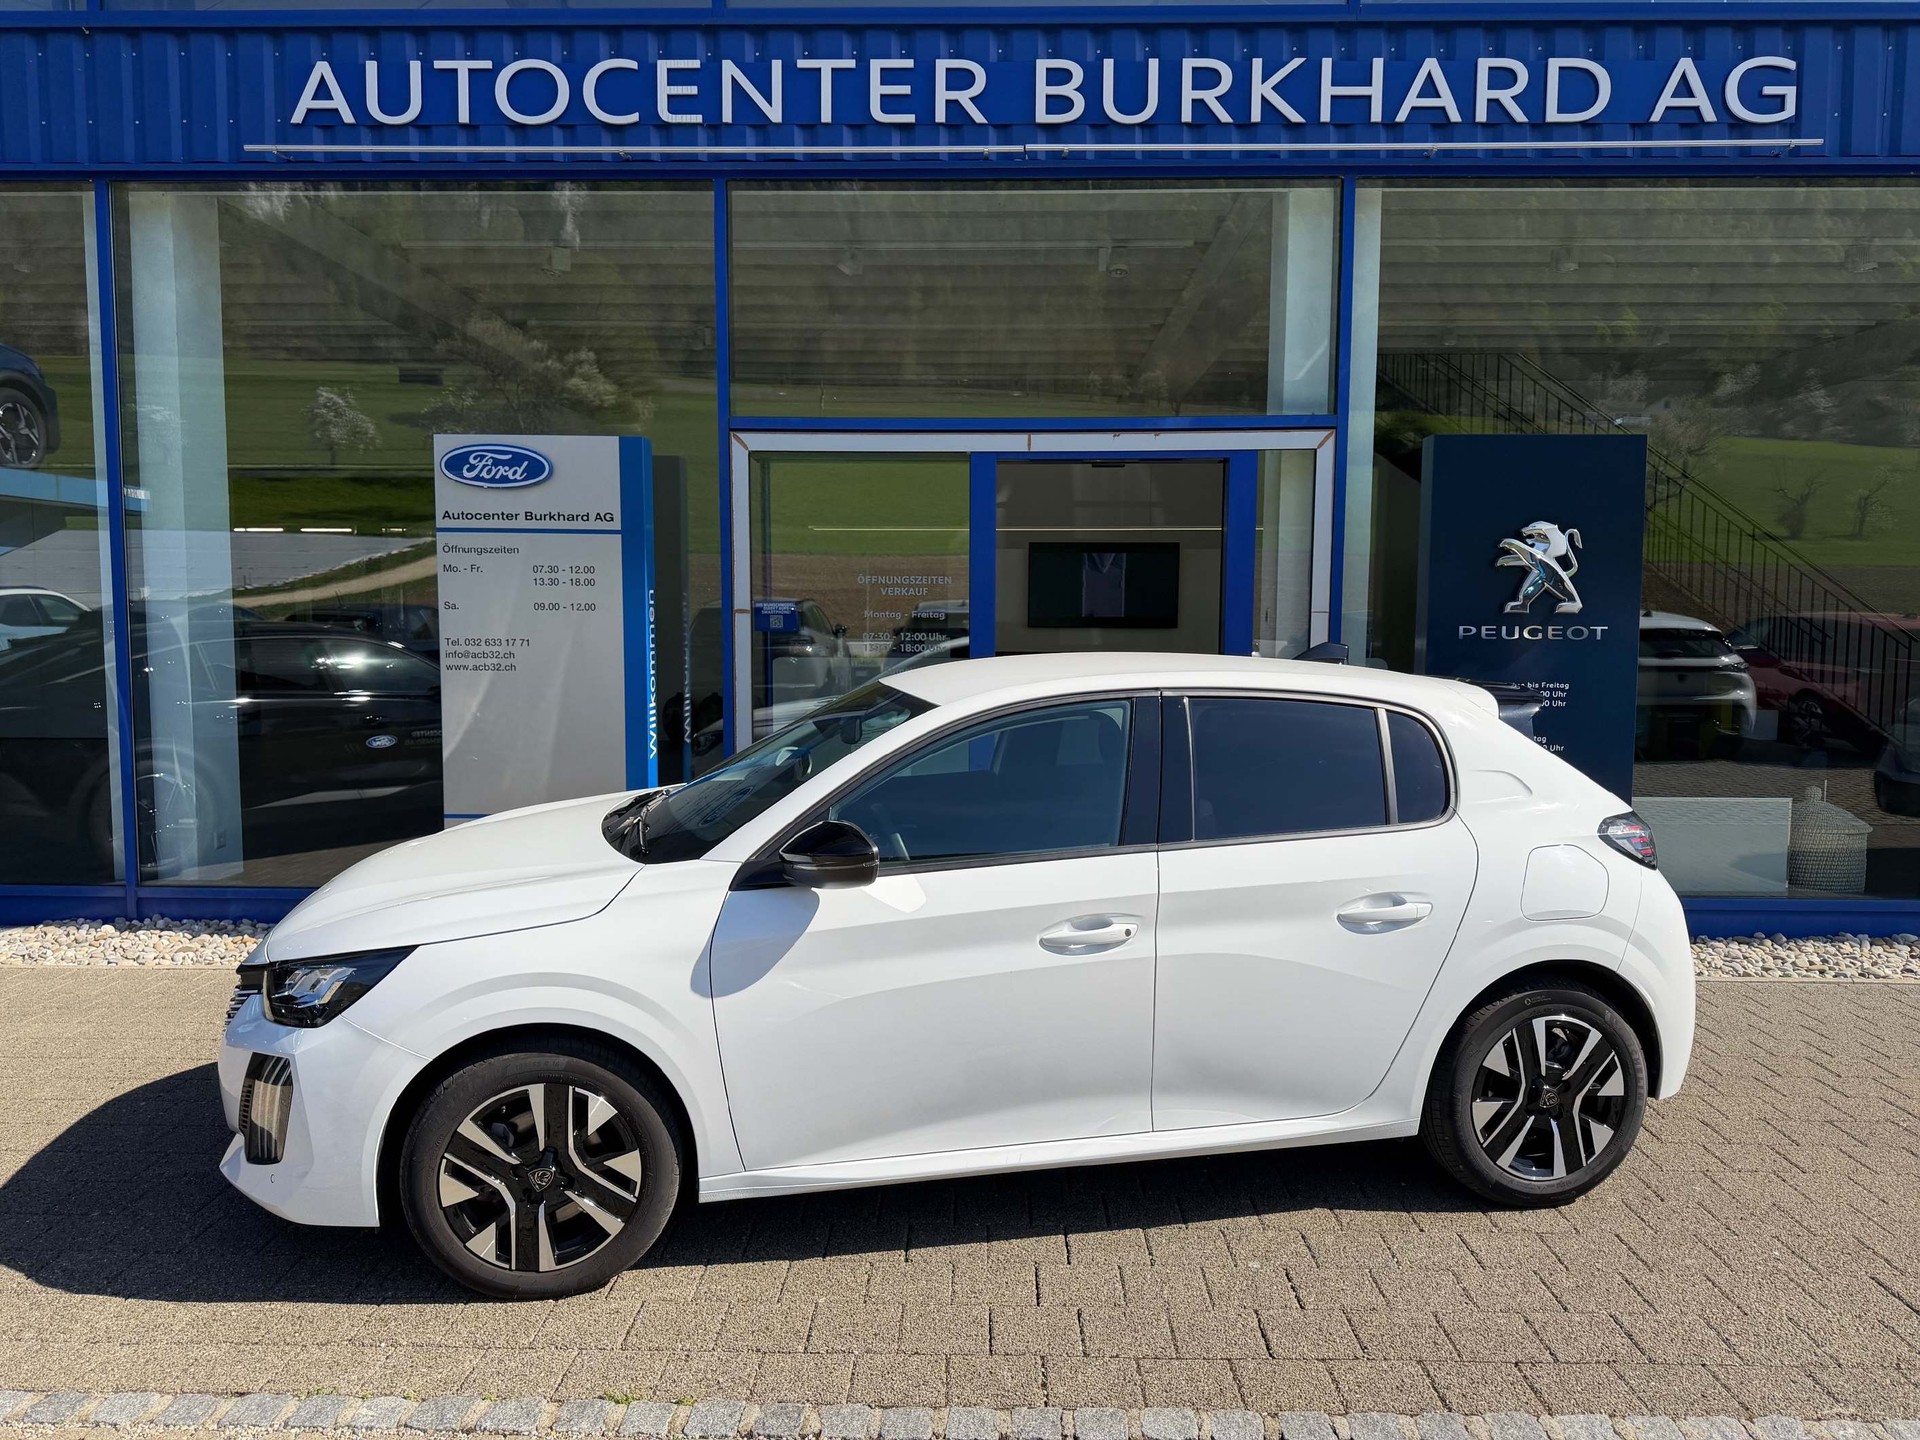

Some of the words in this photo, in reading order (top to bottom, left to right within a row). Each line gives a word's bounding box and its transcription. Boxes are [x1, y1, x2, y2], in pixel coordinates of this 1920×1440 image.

[290, 58, 989, 125] AUTOCENTER
[1035, 57, 1612, 125] BURKHARD
[1648, 55, 1797, 123] AG
[462, 451, 529, 481] Ford
[441, 510, 521, 521] Autocenter
[524, 511, 590, 522] Burkhard
[593, 512, 615, 523] AG
[442, 543, 520, 556] Öffnungszeiten
[442, 563, 462, 573] Mo.
[470, 563, 484, 573] Fr.
[532, 564, 560, 575] 07.30
[568, 565, 596, 575] 12.00
[533, 577, 560, 587] 13.30
[569, 577, 596, 587] 18.00
[857, 575, 952, 585] ÖFFNUNGSZEITEN
[880, 587, 929, 596] VERKAUF
[443, 600, 460, 610] Sa.
[533, 602, 561, 612] 09.00
[570, 602, 597, 612] 12.00
[864, 610, 902, 620] Montag
[911, 610, 945, 620] Freitag
[862, 632, 890, 641] 07:30
[900, 632, 926, 641] 12:00
[928, 632, 946, 641] Uhr
[1458, 625, 1609, 640] PEUGEOT
[444, 637, 463, 647] Tel.
[464, 637, 483, 647] 032
[484, 637, 503, 647] 633
[504, 638, 517, 647] 17
[519, 638, 531, 647] 71
[900, 643, 926, 652] 18:00
[445, 649, 516, 660] info@acb32.ch
[445, 662, 517, 672] www.acb32.ch
[648, 589, 657, 759] Willkommen
[1541, 681, 1570, 690] Freitag
[1552, 690, 1567, 698] Uhr
[1552, 699, 1567, 707] Uhr
[1549, 744, 1564, 752] Uhr
